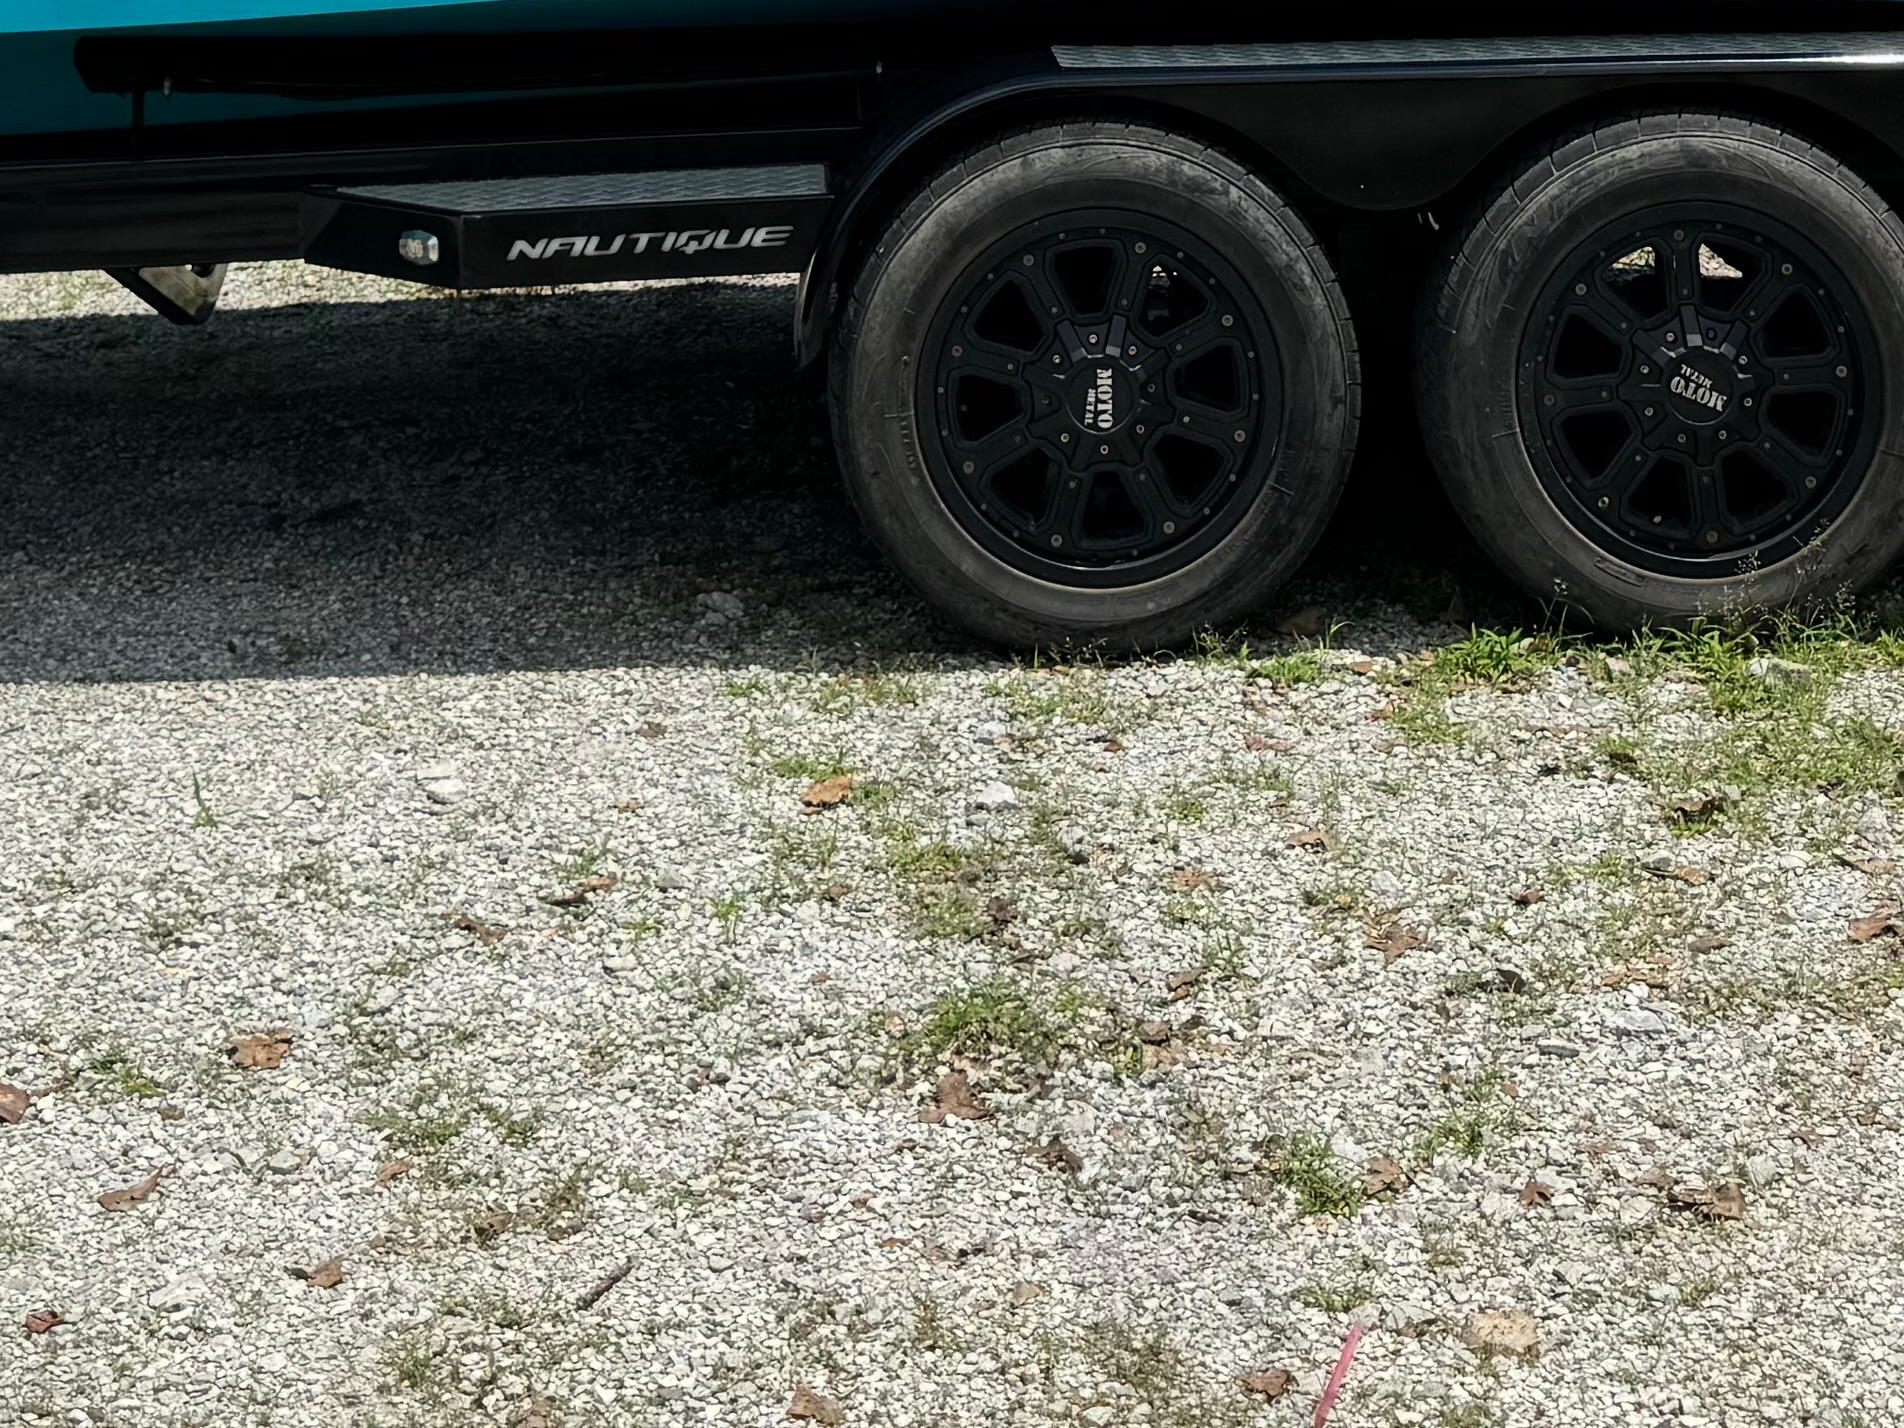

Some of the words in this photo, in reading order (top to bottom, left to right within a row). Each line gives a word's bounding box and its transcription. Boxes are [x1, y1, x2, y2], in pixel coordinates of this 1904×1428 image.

[506, 225, 794, 261] NAUTIQUE
[1681, 364, 1712, 388] METAL
[1084, 388, 1096, 425] METAL
[1097, 368, 1113, 428] MOTO
[1671, 377, 1727, 412] MOTO
